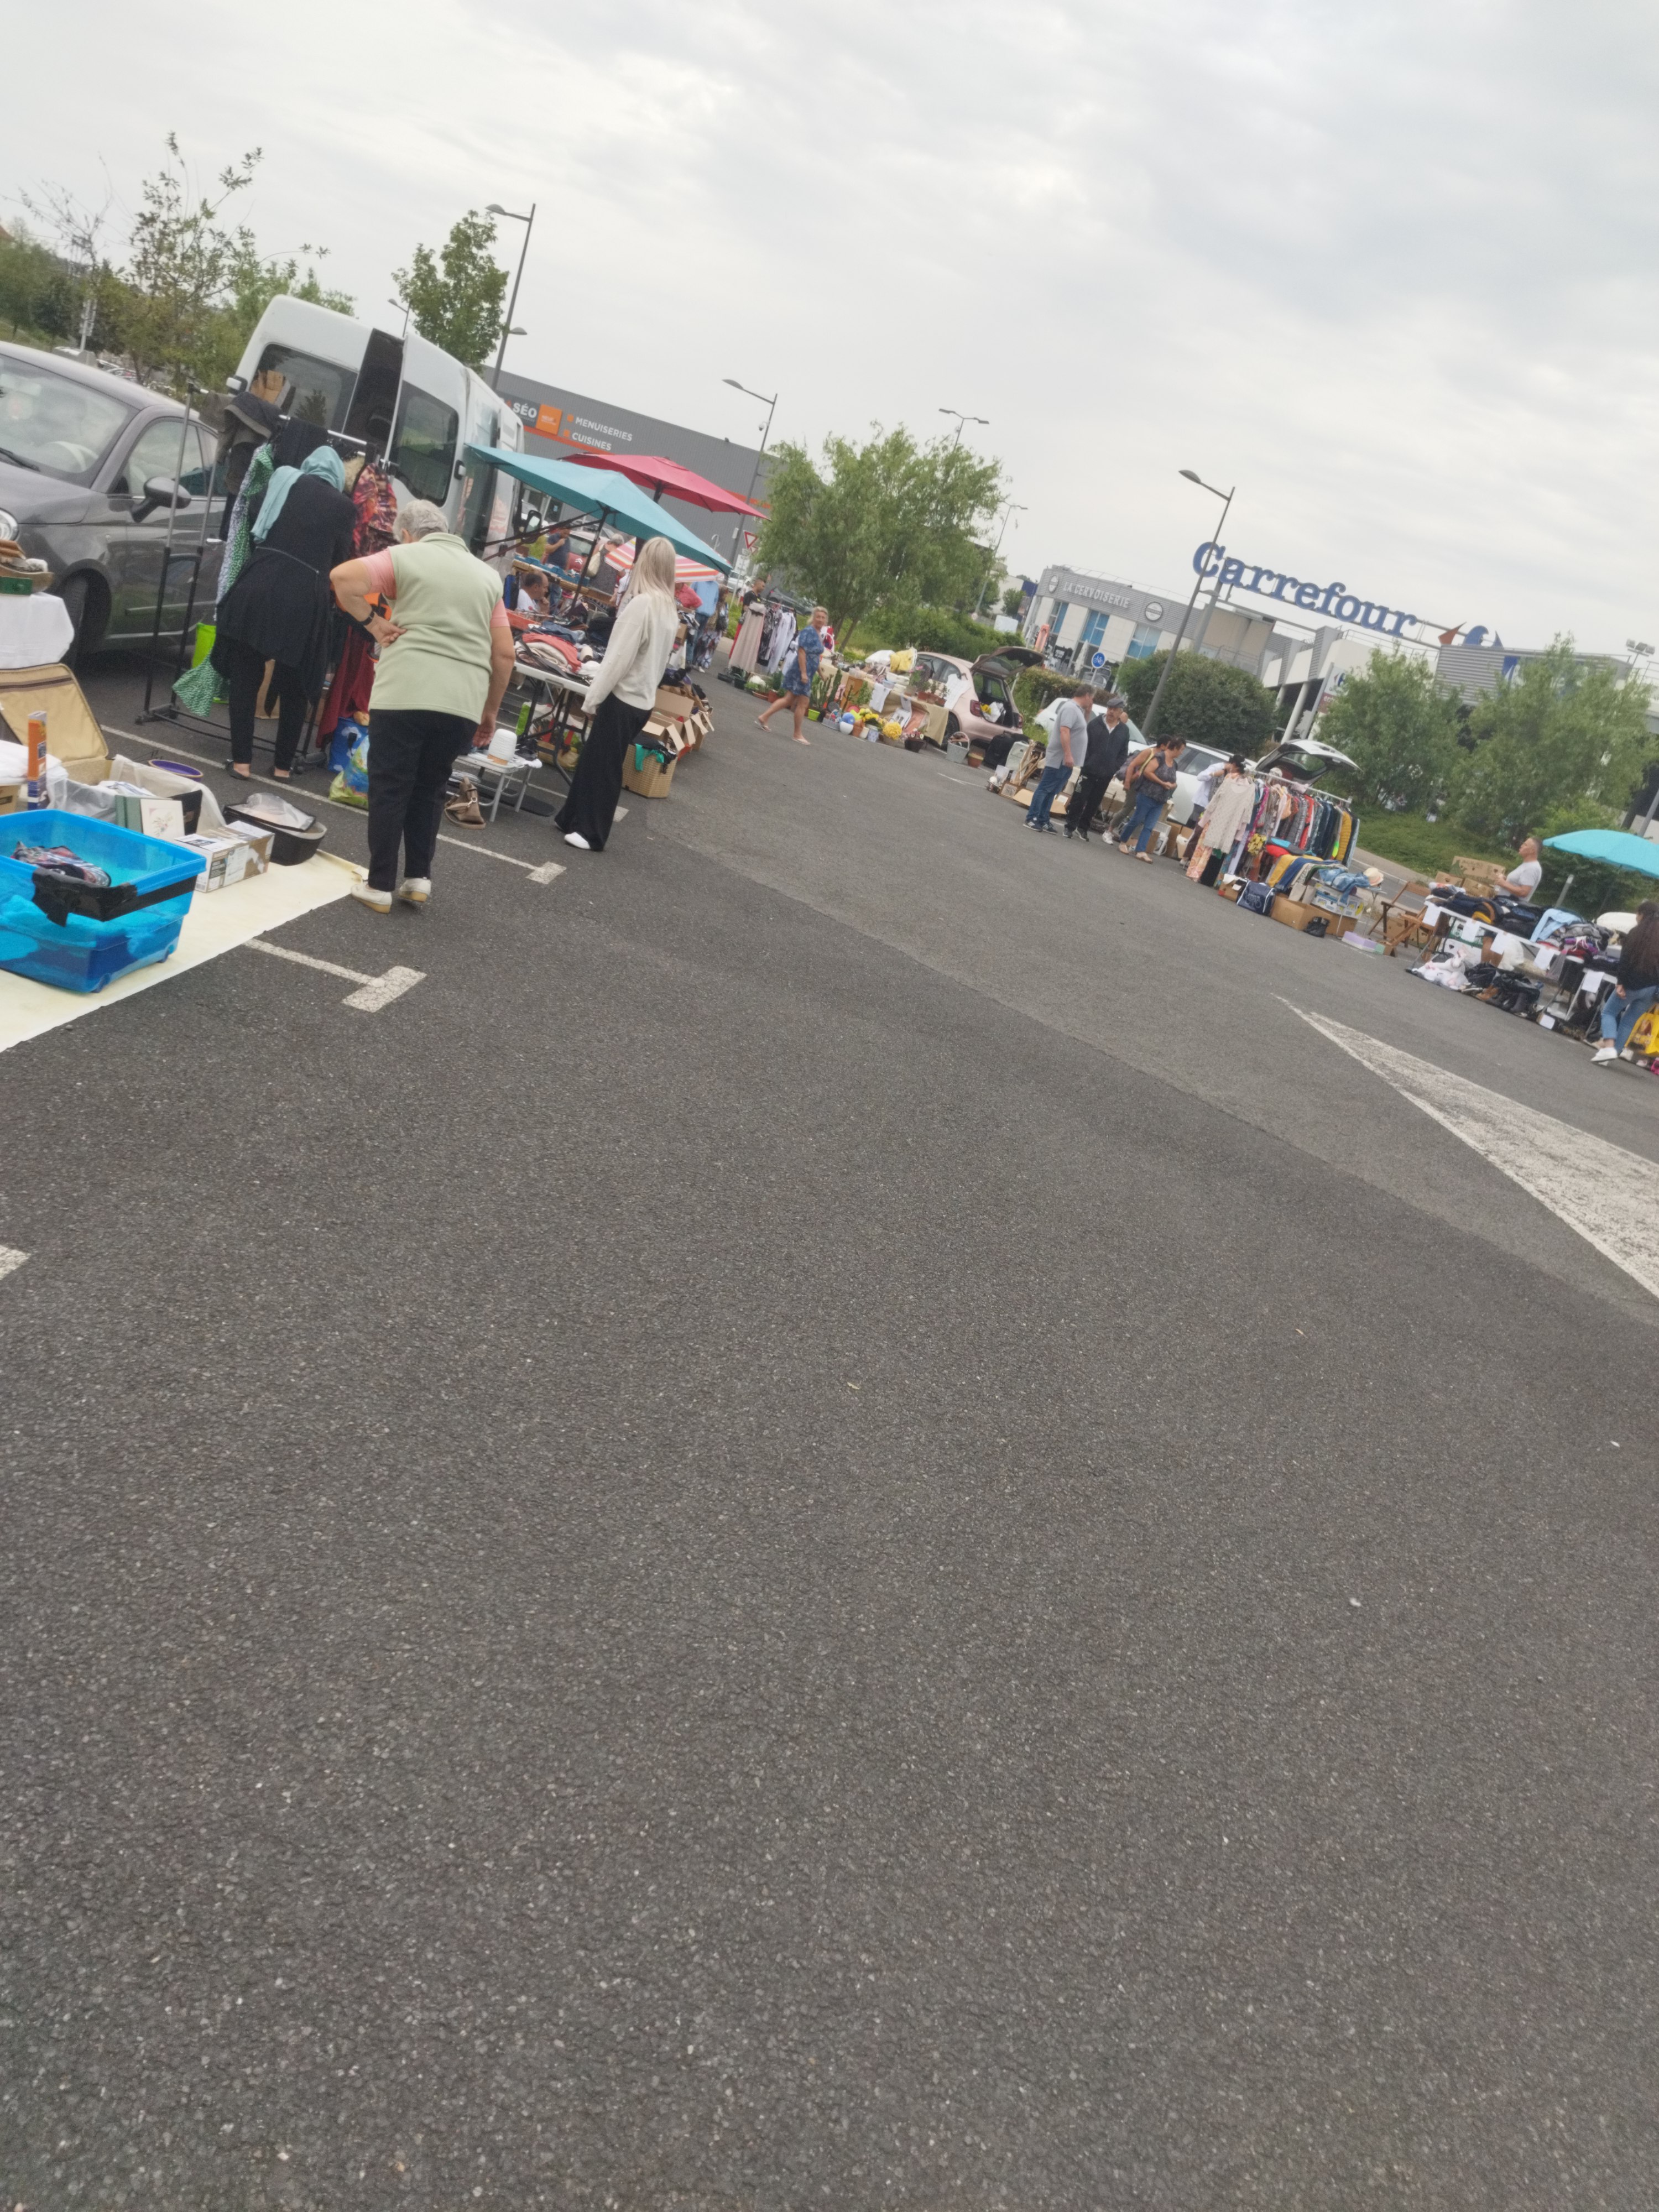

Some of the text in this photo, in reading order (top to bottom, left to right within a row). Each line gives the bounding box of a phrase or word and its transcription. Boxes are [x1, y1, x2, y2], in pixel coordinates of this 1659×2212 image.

[575, 416, 633, 441] MENUISERIES
[572, 432, 612, 451] CUISINES
[1063, 582, 1130, 608] LA CERVOISERIE
[1192, 541, 1417, 638] Carrefour
